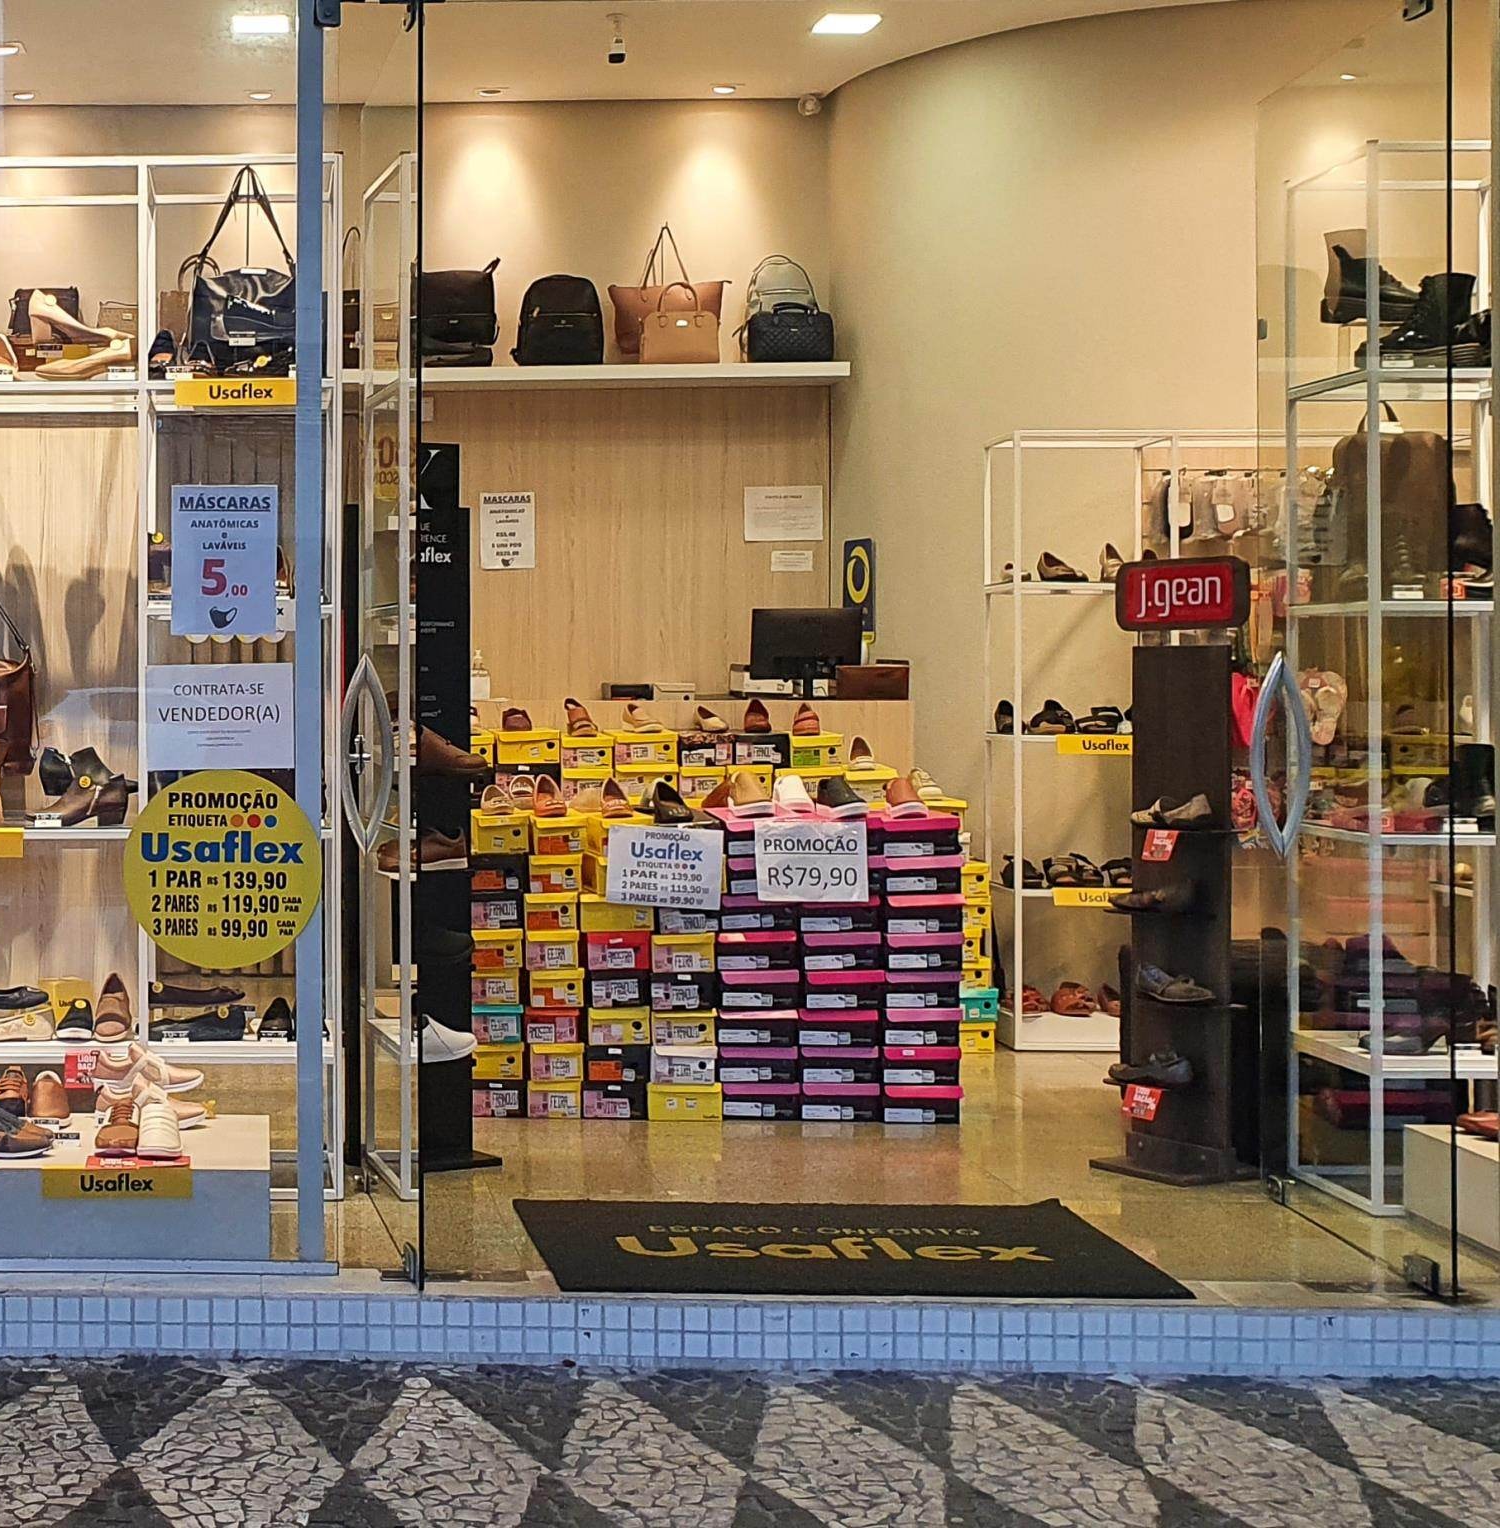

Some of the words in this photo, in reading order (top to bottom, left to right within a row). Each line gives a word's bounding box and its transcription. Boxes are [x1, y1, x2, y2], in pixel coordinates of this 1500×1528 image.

[209, 383, 274, 399] Usaflex
[179, 493, 271, 511] MÁSCARAS
[190, 518, 259, 529] ANATÔMICAS
[202, 541, 247, 550] LAVÁVEIS
[201, 558, 249, 598] 5,00
[1136, 573, 1222, 618] j.gean
[173, 683, 265, 697] CONTRATA-SE
[158, 704, 280, 724] VENDEDOR(A)
[1082, 740, 1130, 751] Usaflex
[168, 789, 278, 813] PROMOÇÃO
[168, 814, 228, 827] ETIQUETA
[645, 831, 691, 842] PROMOÇÃO
[763, 836, 858, 855] PROMOÇÃO
[141, 830, 304, 864] Usaflex
[630, 842, 704, 861] Usaflex
[622, 869, 628, 877] 1
[630, 869, 658, 879] PAR
[636, 861, 673, 869] ETIQUETA
[148, 871, 157, 888] 1
[166, 870, 202, 888] PAR
[207, 876, 219, 886] R$
[222, 871, 287, 893] 139,90
[622, 881, 628, 889] 2
[629, 882, 658, 891] PARES
[767, 865, 858, 890] R$79,90
[152, 894, 161, 912] 2
[165, 894, 199, 913] PARES
[207, 904, 217, 913] R$
[222, 894, 280, 916] 119,90
[628, 894, 658, 903] PARES
[1078, 892, 1109, 903] Usaf
[153, 918, 162, 936] 3
[165, 918, 199, 936] PARES
[208, 928, 217, 936] R$
[221, 919, 268, 940] 99,90
[80, 1173, 154, 1193] Usaflex
[648, 1225, 782, 1235] ESPAÇO
[615, 1236, 1055, 1262] Usaflex
